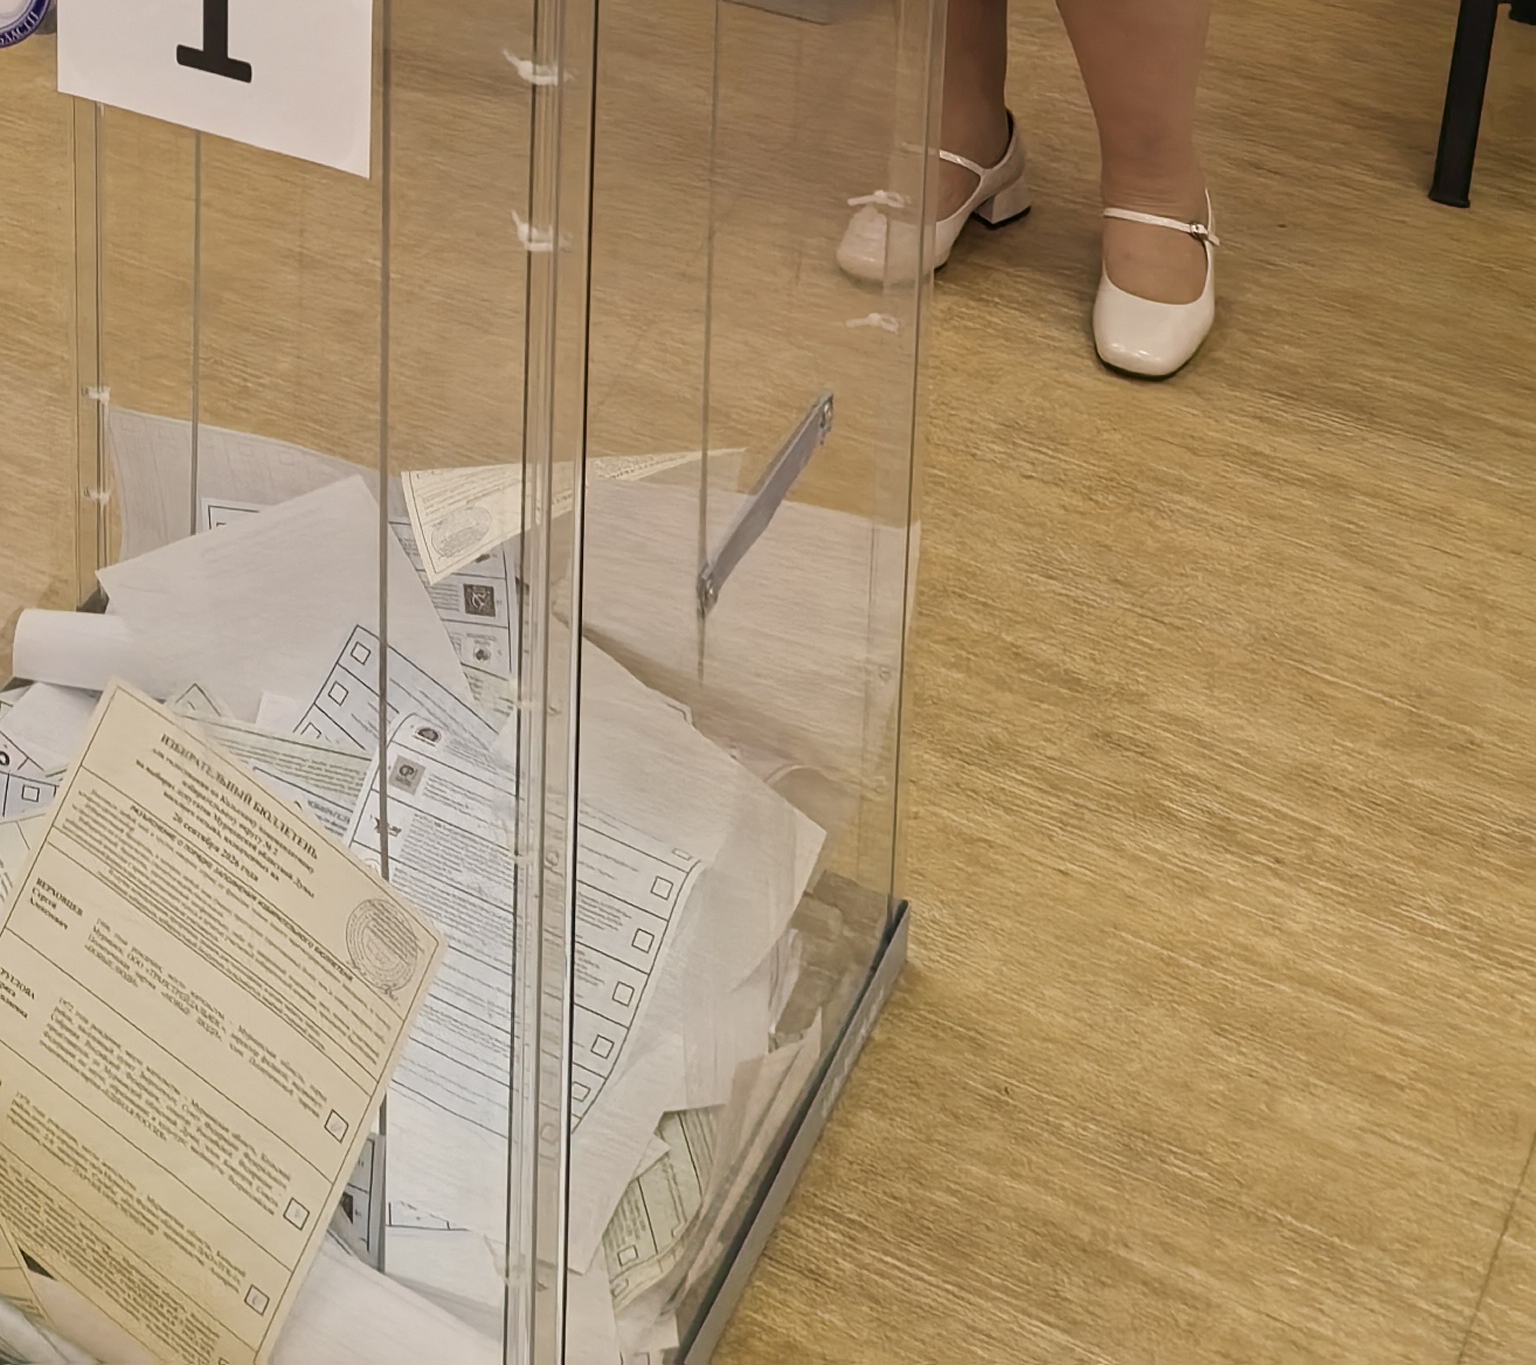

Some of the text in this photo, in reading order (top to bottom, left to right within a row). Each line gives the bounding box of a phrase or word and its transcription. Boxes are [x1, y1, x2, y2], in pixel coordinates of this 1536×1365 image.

[161, 733, 252, 806] ИЗБИРАТЕЛЬНЫЙ
[253, 801, 317, 860] БЮЛЛЕТЕНЬ
[172, 812, 183, 824] 20
[183, 822, 220, 853] сентября
[240, 865, 259, 882] года
